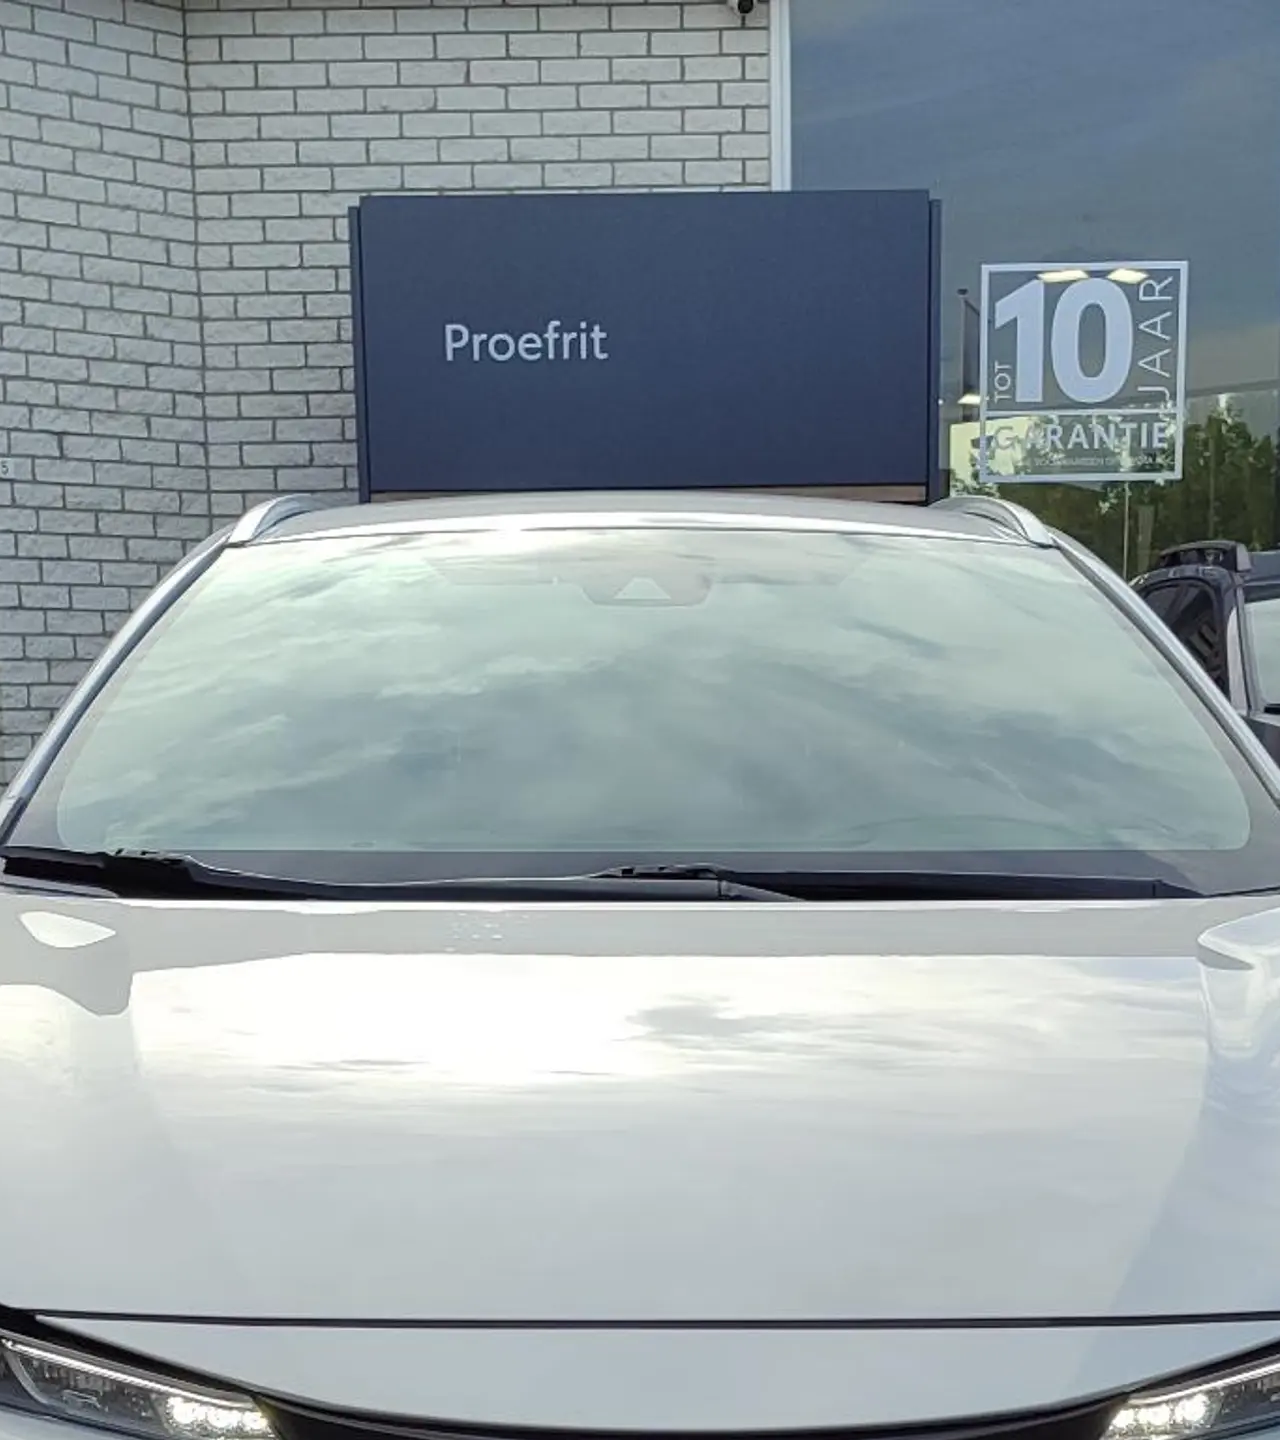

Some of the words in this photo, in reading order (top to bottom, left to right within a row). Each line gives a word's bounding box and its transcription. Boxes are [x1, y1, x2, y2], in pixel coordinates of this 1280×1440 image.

[444, 320, 609, 362] Proefrit
[994, 277, 1133, 404] 10
[1136, 275, 1174, 405] JAAR
[993, 361, 1012, 403] TOT
[994, 421, 1168, 452] GARANTIE
